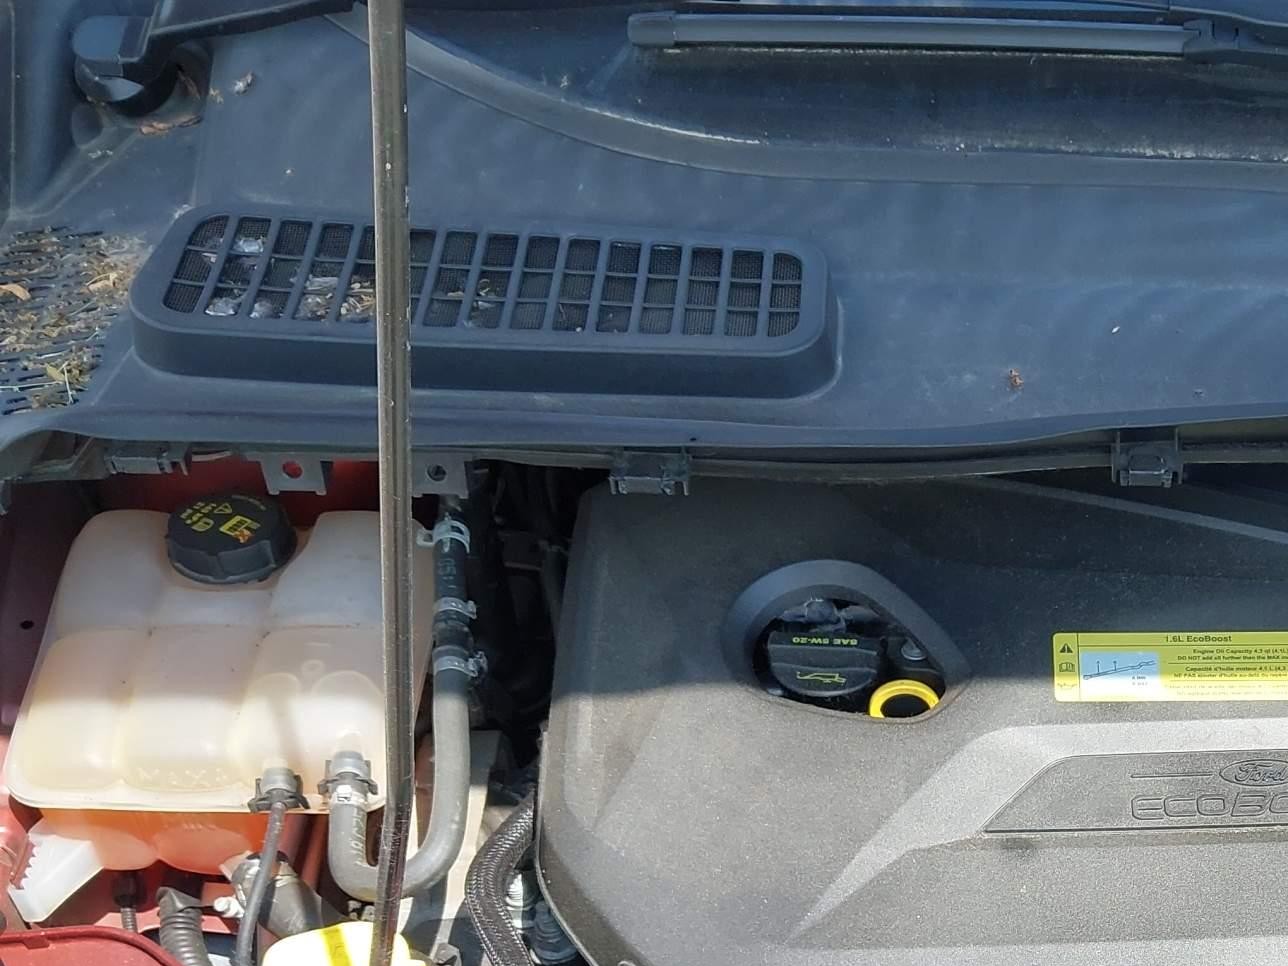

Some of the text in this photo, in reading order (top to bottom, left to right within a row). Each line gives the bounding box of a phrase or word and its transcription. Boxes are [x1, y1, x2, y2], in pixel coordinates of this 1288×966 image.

[791, 636, 858, 646] SAE 5W-20
[1166, 635, 1232, 643] 1.6L EcoBoost
[1233, 763, 1288, 783] Ford
